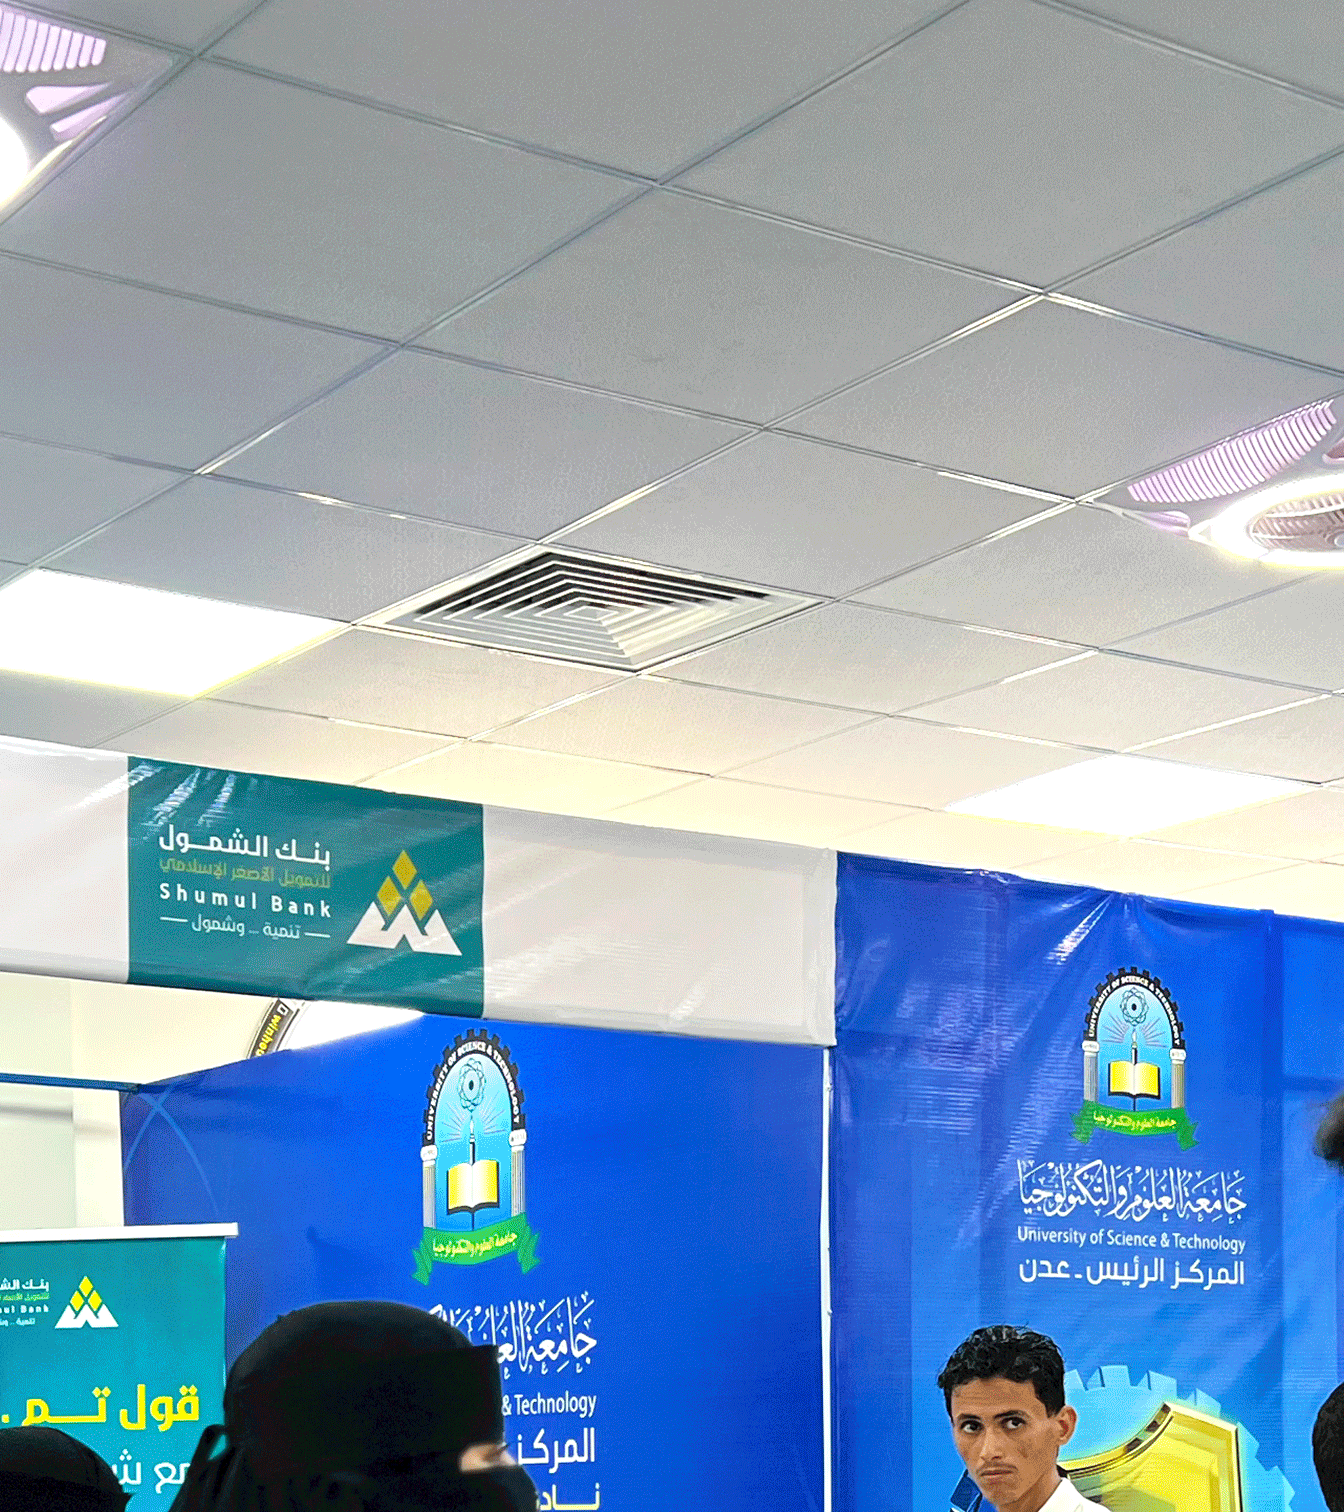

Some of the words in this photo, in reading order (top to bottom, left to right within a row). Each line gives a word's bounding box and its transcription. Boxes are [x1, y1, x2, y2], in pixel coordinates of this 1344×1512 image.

[158, 823, 269, 858] الشمول
[275, 838, 331, 871] بنك
[159, 882, 257, 910] Shumul
[271, 894, 332, 918] Bank
[1017, 1226, 1087, 1249] University
[1090, 1228, 1105, 1245] of
[1107, 1229, 1158, 1248] Science
[1160, 1232, 1171, 1248] &
[1172, 1232, 1246, 1256] Technology
[1019, 1258, 1071, 1283] عدن
[1086, 1255, 1165, 1289] الرئيس
[1170, 1258, 1245, 1291] المركز
[119, 1384, 200, 1432] قول
[513, 1390, 597, 1419] Technology
